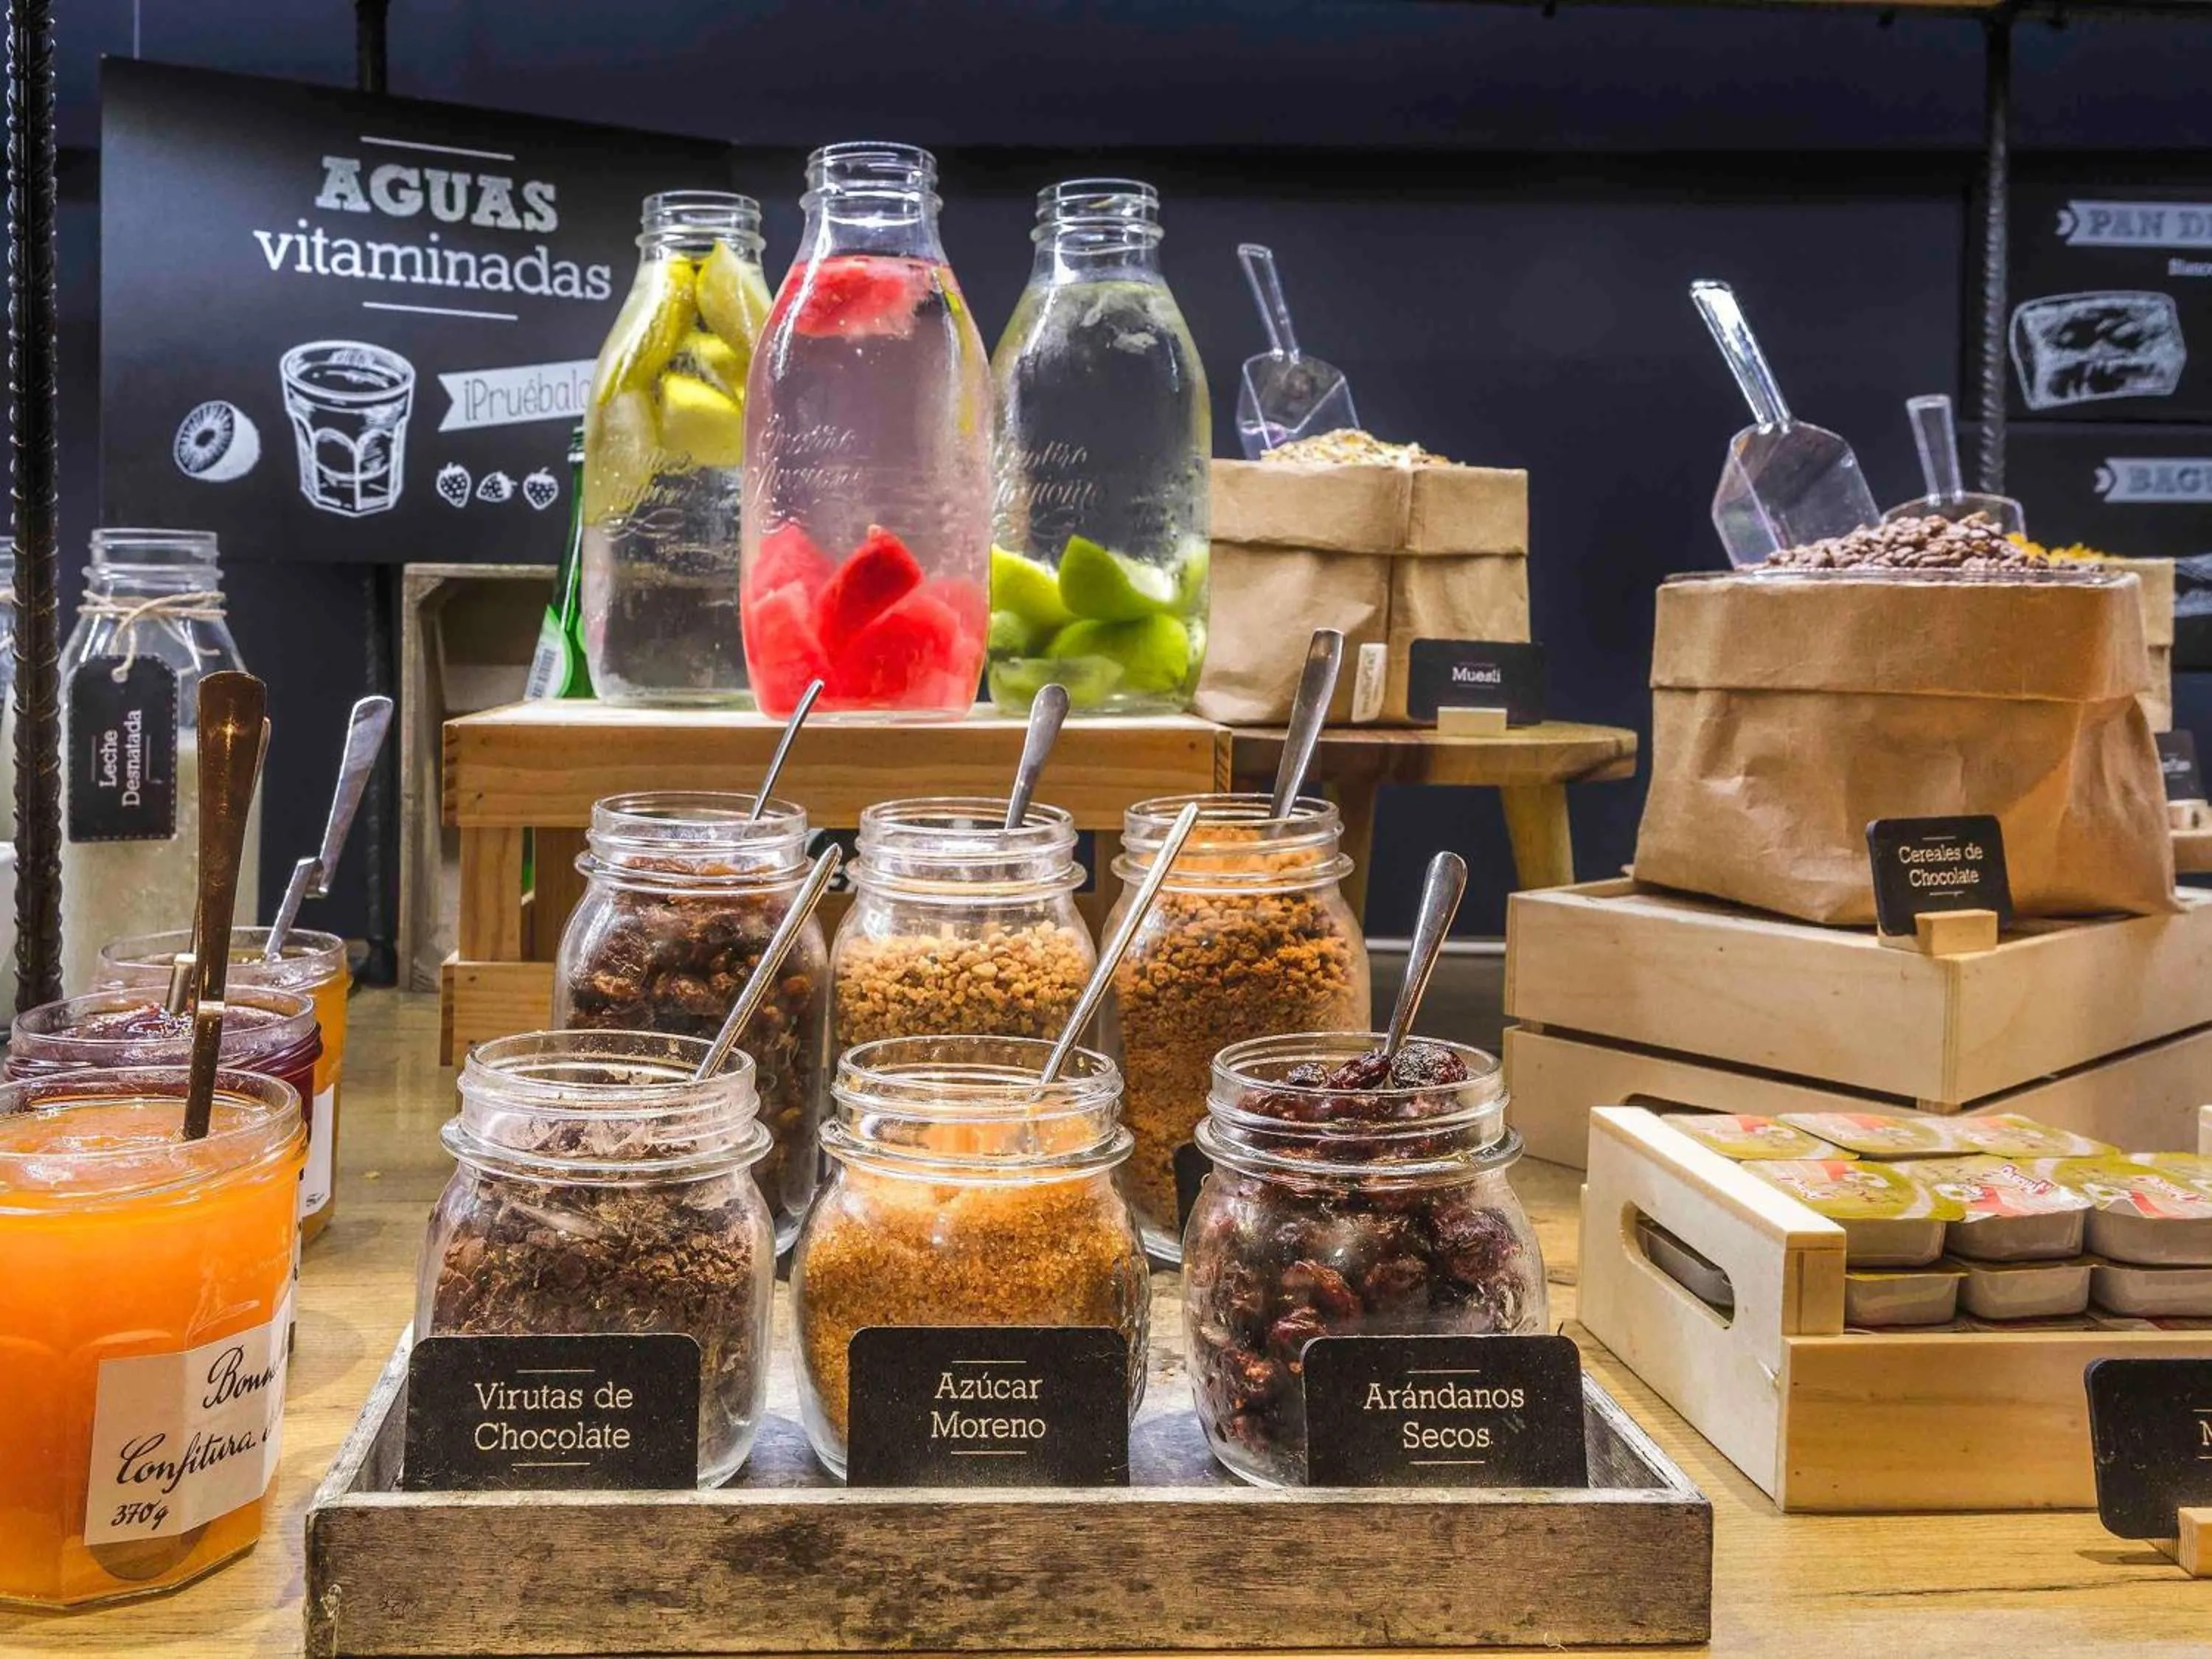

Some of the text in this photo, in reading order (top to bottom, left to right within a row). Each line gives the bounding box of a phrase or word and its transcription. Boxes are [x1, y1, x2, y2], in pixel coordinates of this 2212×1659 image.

[315, 155, 558, 233] AGUAS
[2088, 209, 2165, 238] PAN
[252, 219, 612, 302] vitaminadas
[1451, 667, 1501, 684] Muesli
[99, 729, 119, 787] Leche
[122, 709, 143, 807] Desnatada
[1899, 843, 1983, 864] Cereales de
[1909, 867, 1980, 888] Chocolate
[202, 1345, 279, 1409] Bonn
[935, 1371, 1040, 1400] Azúcar
[474, 1381, 634, 1411] Virutas de
[1363, 1380, 1525, 1411] Arándanos
[474, 1421, 631, 1451] Chocolate
[931, 1410, 1047, 1439] Moreno
[1402, 1420, 1490, 1450] Secos
[116, 1431, 257, 1495] Confitura
